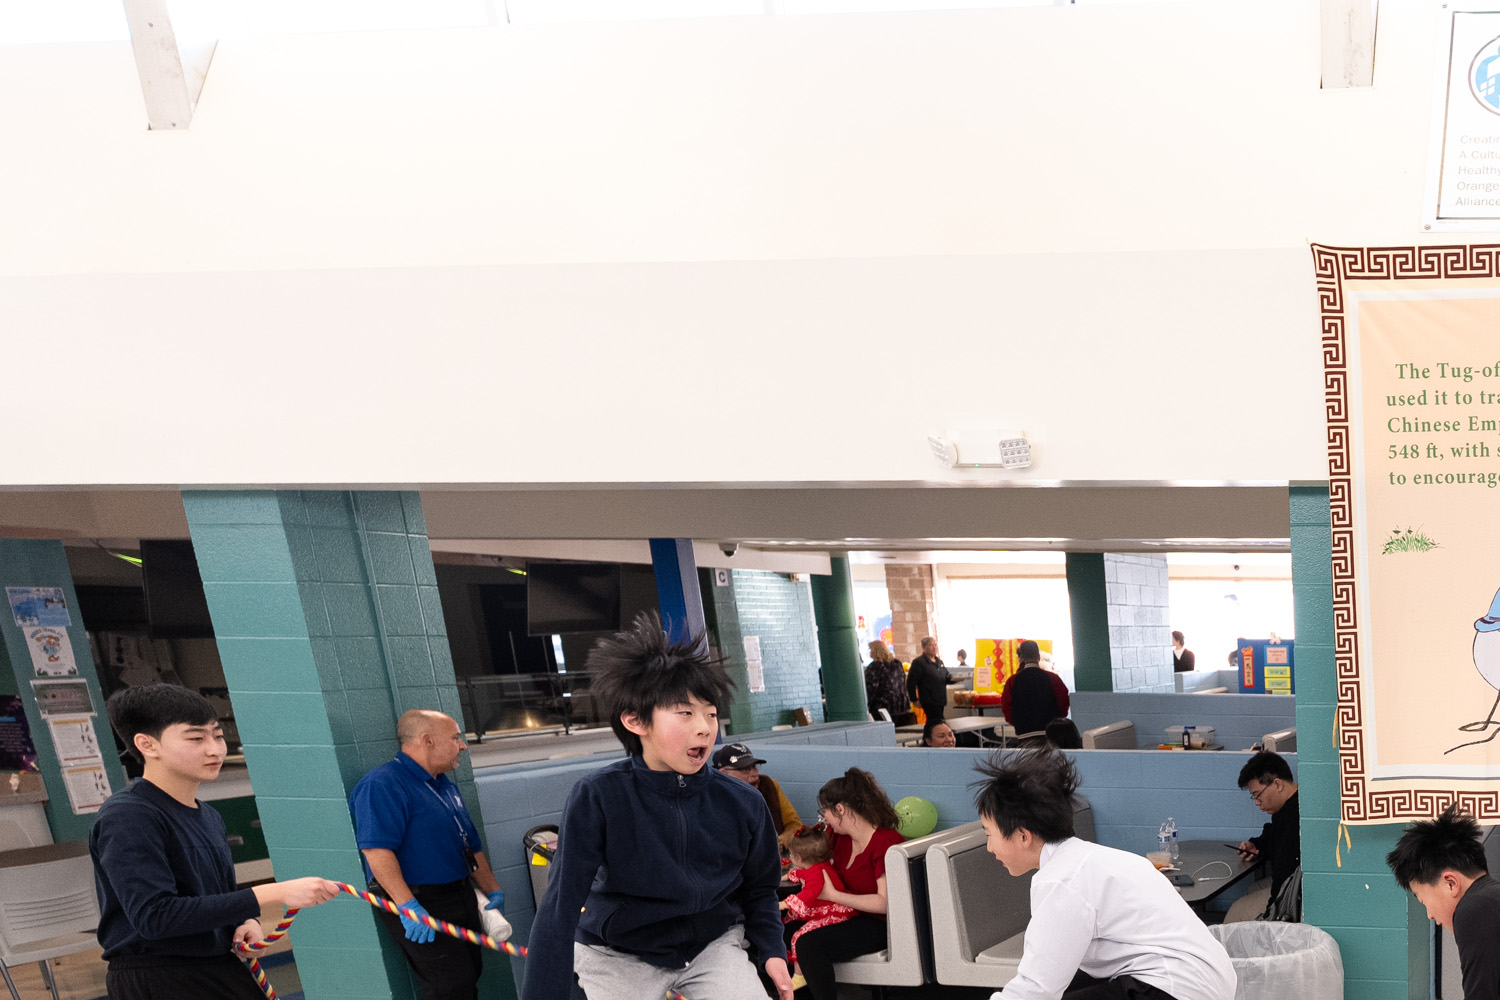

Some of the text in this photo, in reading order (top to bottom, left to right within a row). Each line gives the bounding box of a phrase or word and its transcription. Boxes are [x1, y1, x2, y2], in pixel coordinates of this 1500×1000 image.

[1459, 151, 1467, 159] A
[1457, 182, 1500, 192] Orange
[1395, 363, 1430, 379] The
[1386, 389, 1427, 406] used
[1435, 390, 1448, 405] it
[1455, 391, 1472, 405] to
[1387, 417, 1460, 433] Chinese
[1388, 444, 1419, 459] 548
[1426, 442, 1444, 460] ft,
[1450, 441, 1490, 457] with
[1389, 472, 1406, 485] to
[718, 572, 726, 583] C
